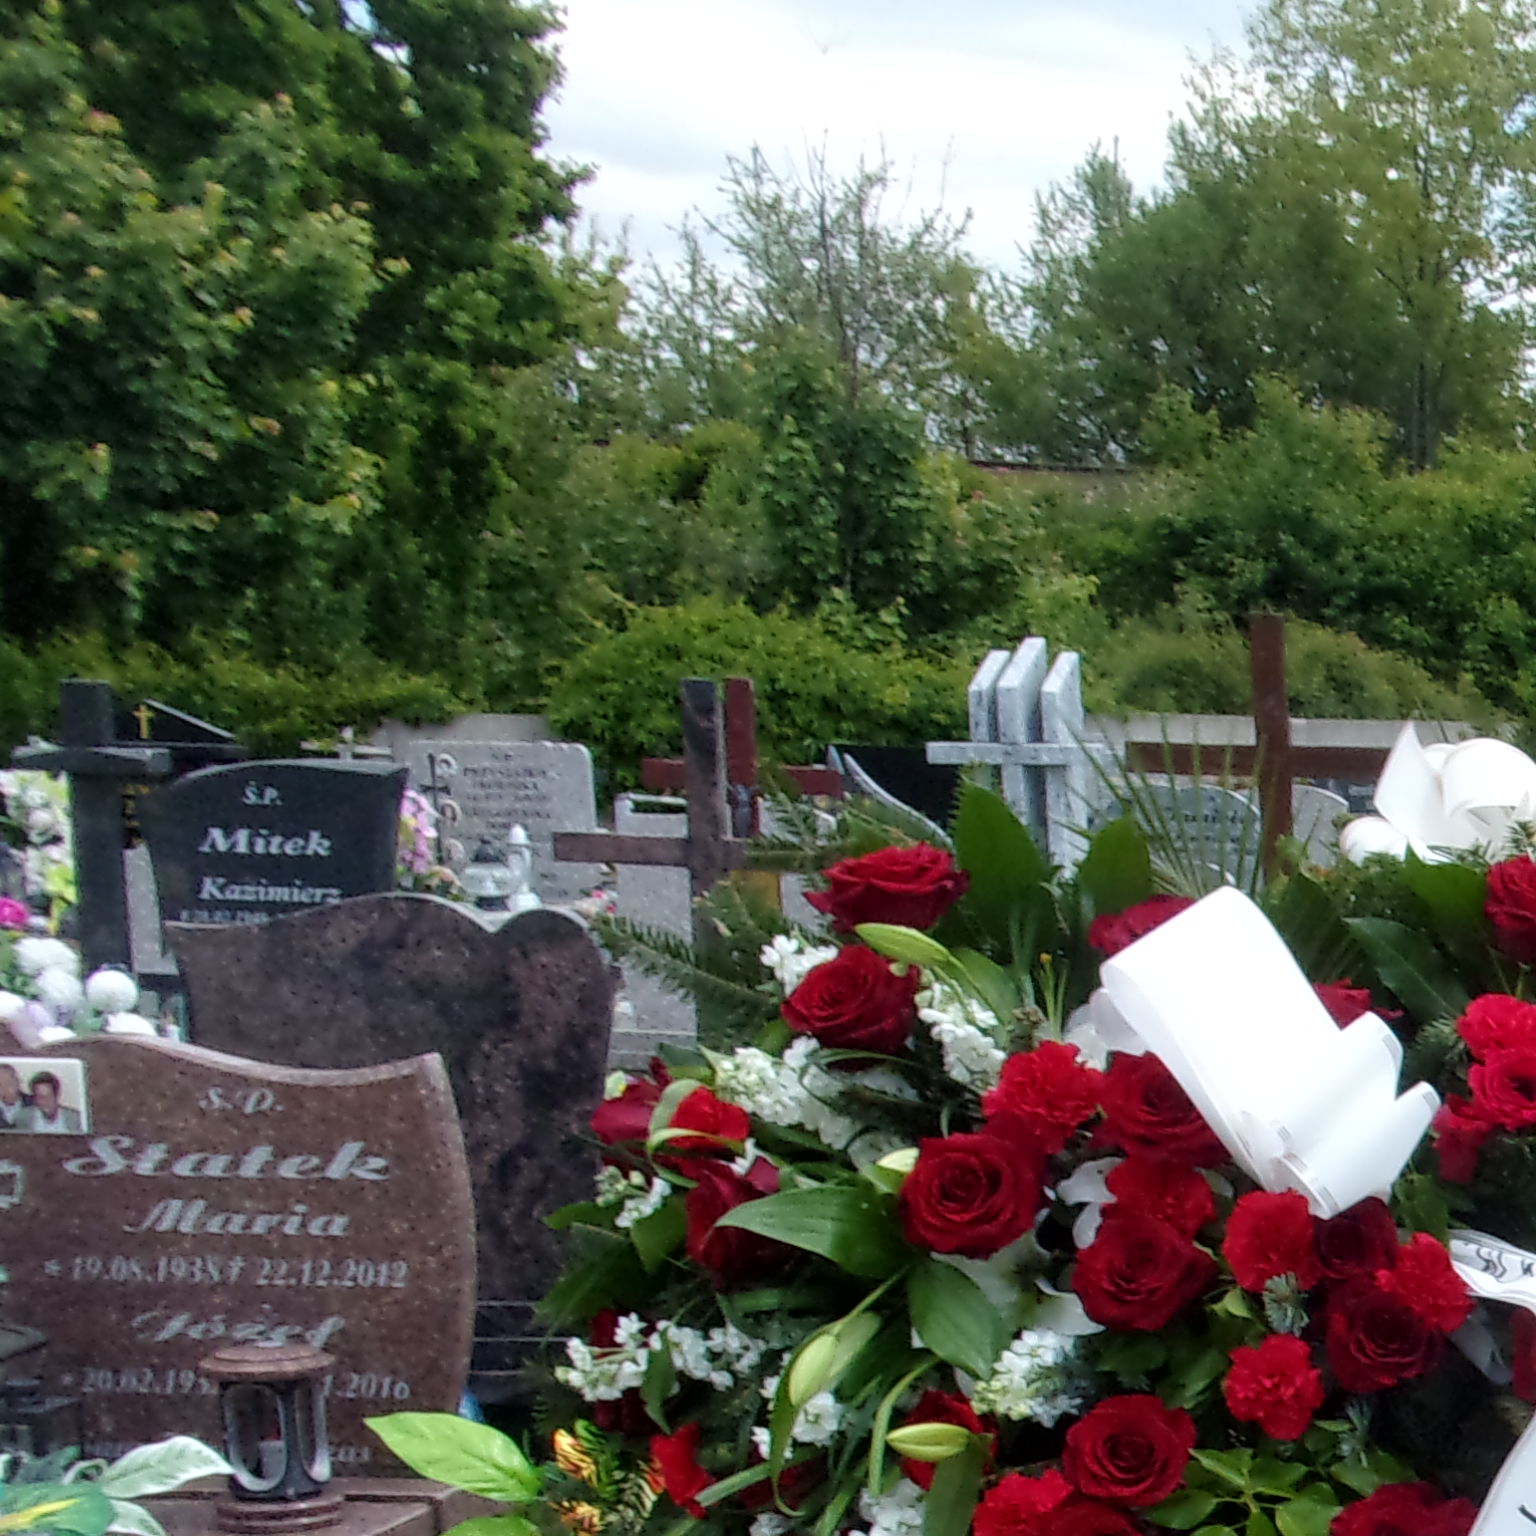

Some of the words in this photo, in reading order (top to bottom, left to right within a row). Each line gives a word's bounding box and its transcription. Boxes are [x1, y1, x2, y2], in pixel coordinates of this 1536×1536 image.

[199, 826, 332, 857] Mitek
[199, 876, 343, 904] Kazimierz
[63, 1134, 391, 1181] Statek
[123, 1198, 352, 1237] Maria
